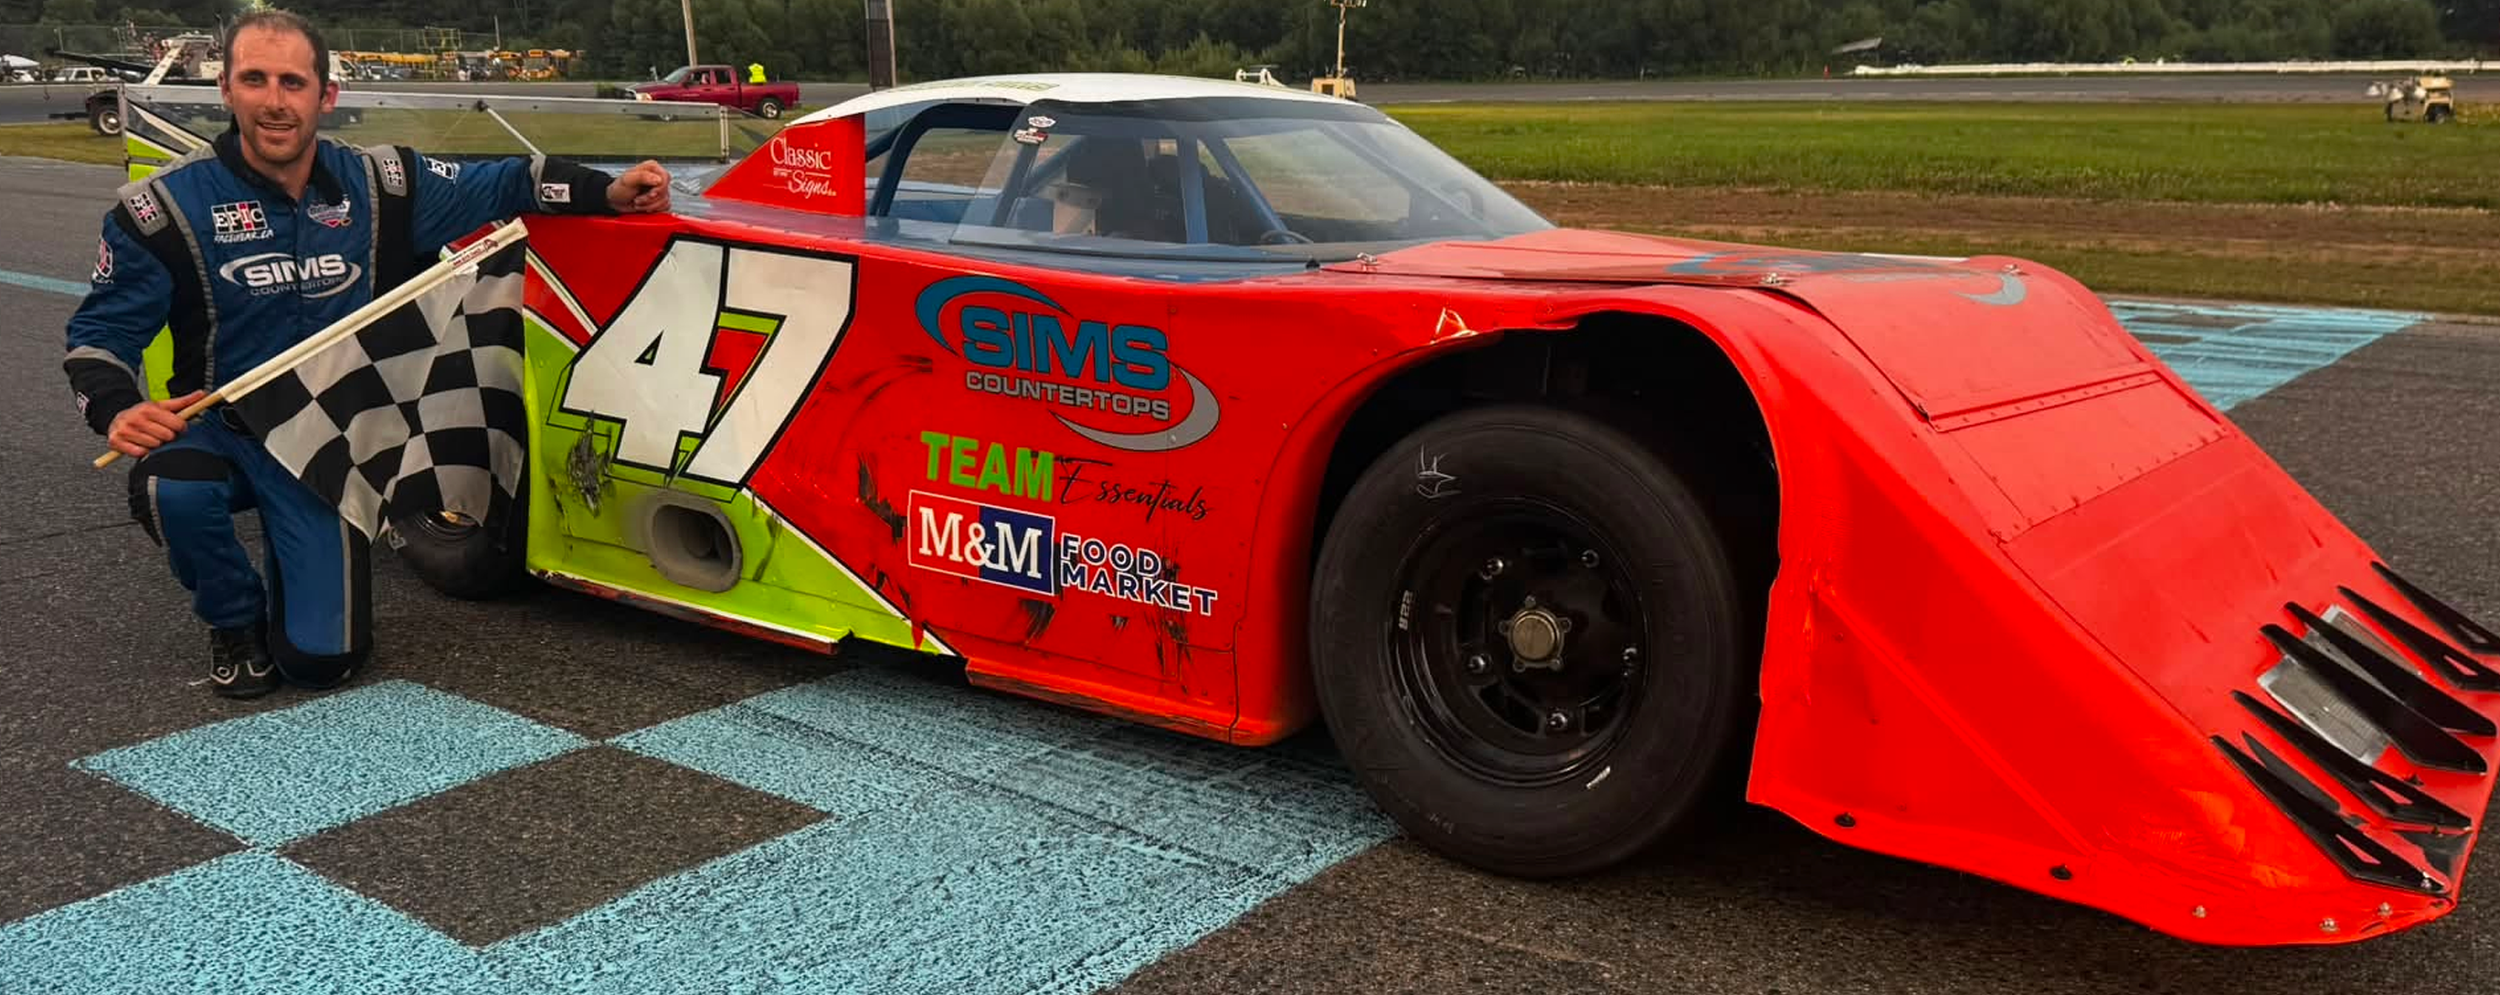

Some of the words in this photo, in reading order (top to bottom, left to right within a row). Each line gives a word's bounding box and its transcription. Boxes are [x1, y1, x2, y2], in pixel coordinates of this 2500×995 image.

[770, 136, 832, 170] Classic
[788, 169, 829, 199] Signs
[213, 207, 266, 228] EPIC
[244, 254, 347, 287] SIMS
[559, 234, 859, 489] 47
[960, 304, 1171, 391] SIMS
[965, 370, 1171, 422] COUNTERTOPS
[921, 430, 1054, 502] TEAM
[1054, 456, 1213, 522] Essentials
[918, 506, 1043, 579] M&M
[1060, 532, 1162, 577] FOOD
[1060, 559, 1219, 616] MARKET
